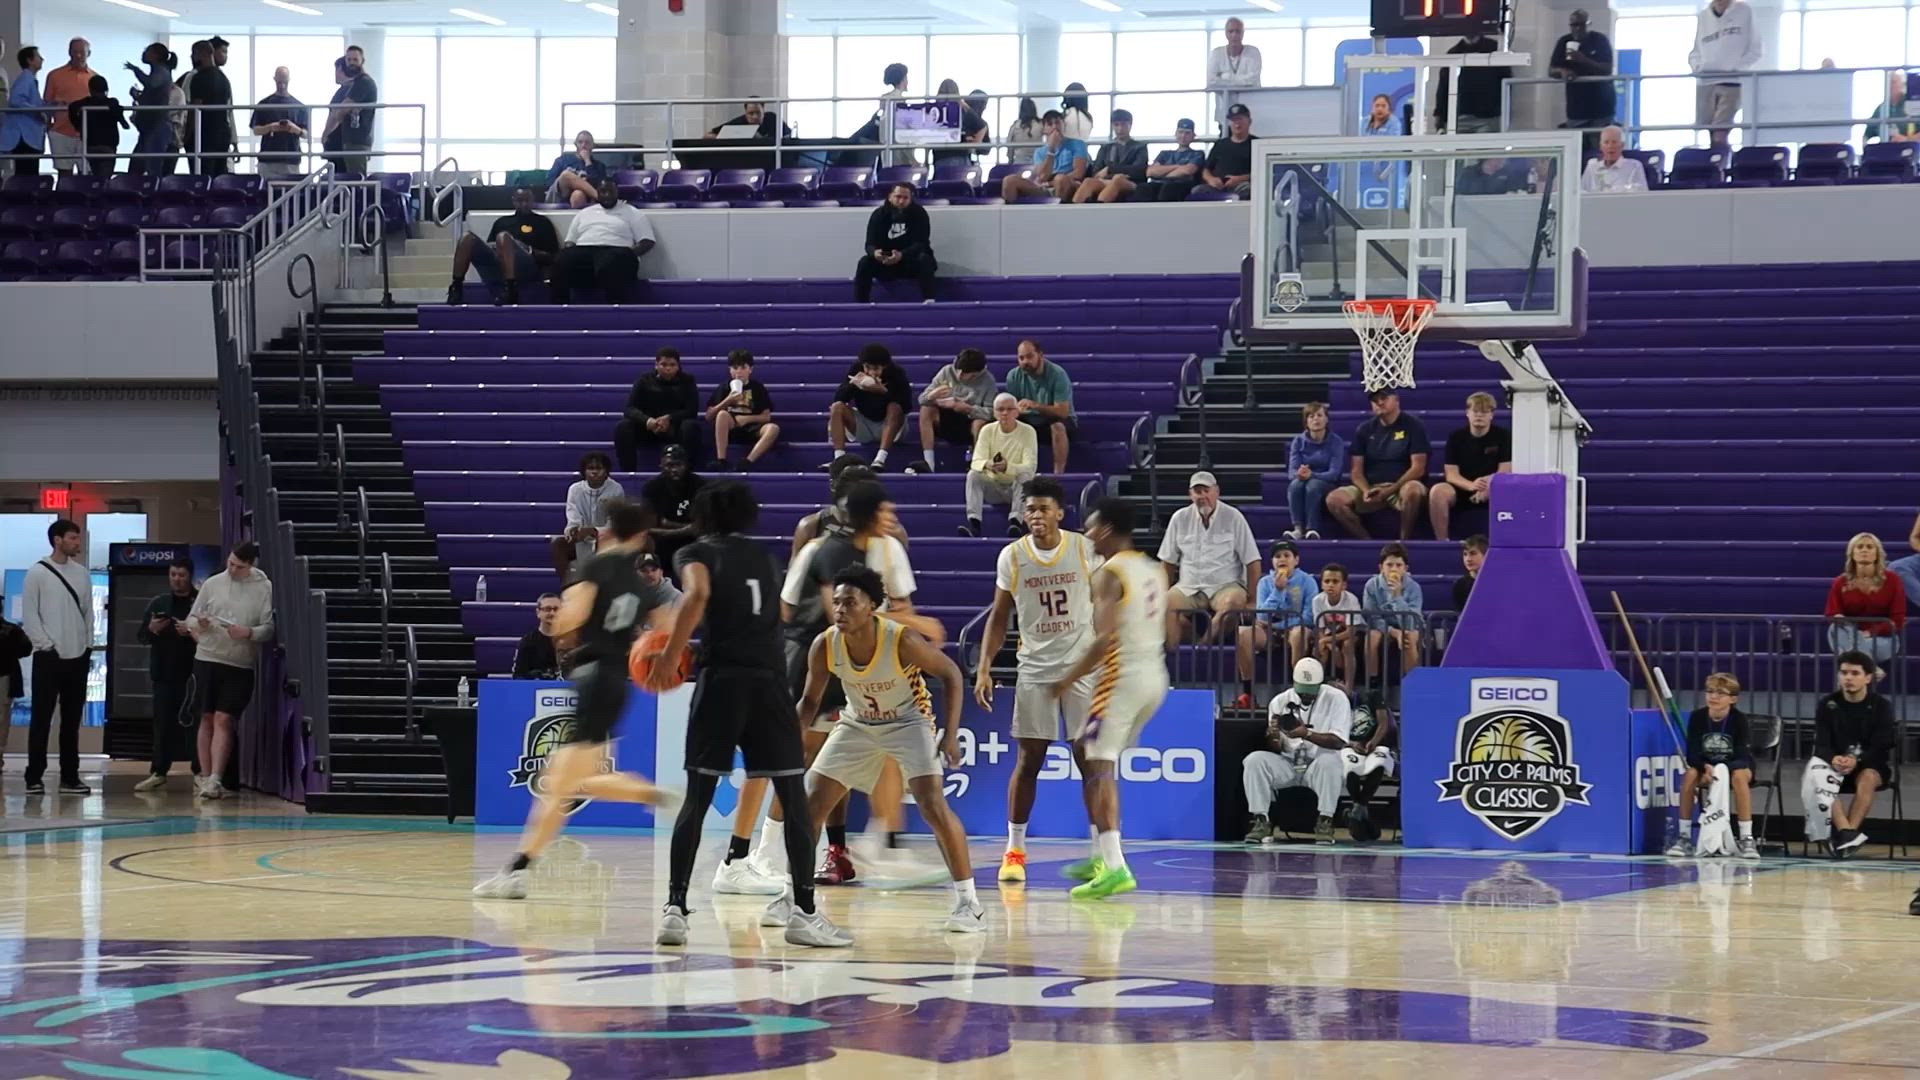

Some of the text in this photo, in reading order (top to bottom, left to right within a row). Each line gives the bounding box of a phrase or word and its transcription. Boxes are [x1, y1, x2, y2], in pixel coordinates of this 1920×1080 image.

[46, 490, 68, 508] EXIT
[140, 551, 175, 564] pepsi
[1024, 572, 1077, 588] MONTVERDE
[746, 578, 762, 615] 1
[1039, 589, 1069, 617] 42
[1036, 620, 1075, 633] ACADEMY
[541, 696, 578, 708] GEIC
[1478, 687, 1548, 701] GEICO
[1456, 762, 1572, 786] CITY OF PALMS
[1635, 755, 1687, 810] GEIC
[1475, 786, 1549, 809] CLASSIC
